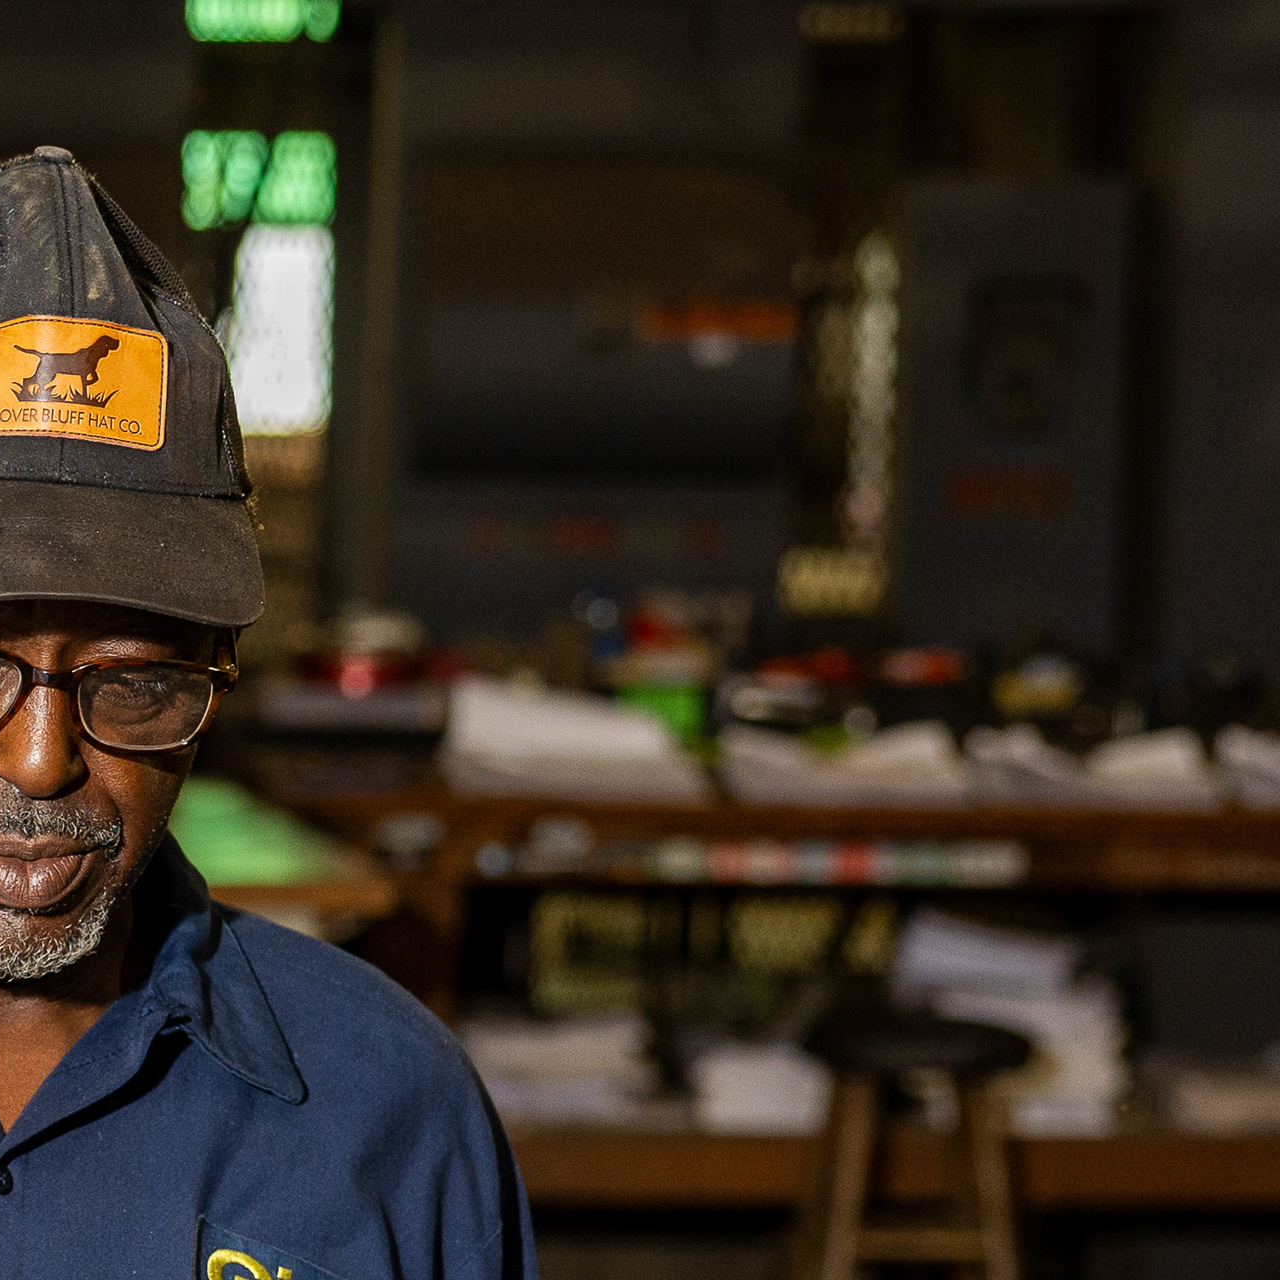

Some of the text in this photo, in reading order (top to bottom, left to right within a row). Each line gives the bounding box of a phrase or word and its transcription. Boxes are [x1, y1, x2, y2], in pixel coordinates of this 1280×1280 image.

[42, 408, 85, 425] BLUFF
[89, 413, 116, 430] HAT
[119, 419, 143, 435] CO.
